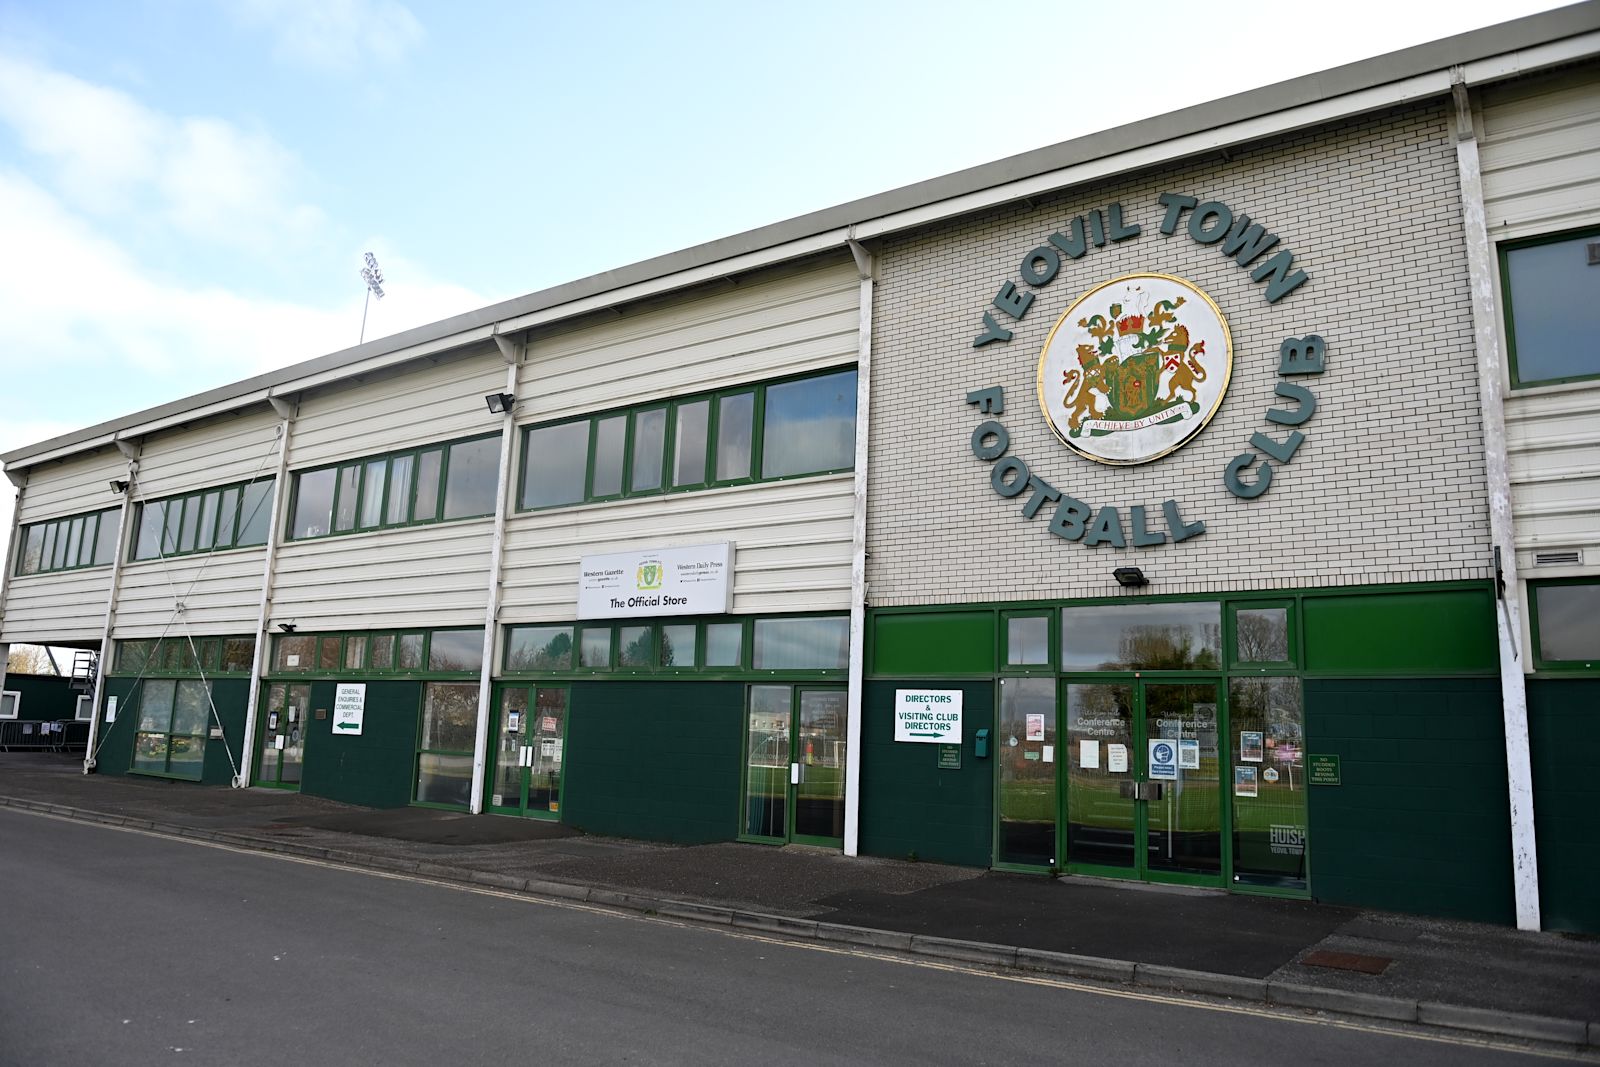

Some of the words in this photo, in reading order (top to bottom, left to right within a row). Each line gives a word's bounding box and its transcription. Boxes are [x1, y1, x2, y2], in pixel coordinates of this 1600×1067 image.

[973, 202, 1141, 348] YEOVIL
[1159, 192, 1310, 304] TOWN
[1093, 421, 1131, 430] ACHIEVE
[1134, 420, 1145, 429] BY
[1148, 408, 1177, 425] UNITY
[966, 385, 1206, 548] FOOTBALL
[1224, 334, 1326, 499] CLUB
[610, 598, 625, 608] The
[627, 595, 660, 608] Official
[663, 595, 688, 606] Store
[905, 694, 952, 703] DIRECTORS
[336, 703, 364, 711] COMMERCIAL
[898, 712, 933, 721] VISITING
[936, 713, 959, 721] CLUB
[904, 721, 951, 731] DIRECTORS
[1077, 717, 1125, 727] Conference
[1156, 718, 1208, 728] Conference
[1087, 727, 1115, 736] Centre
[1167, 729, 1197, 738] Centre
